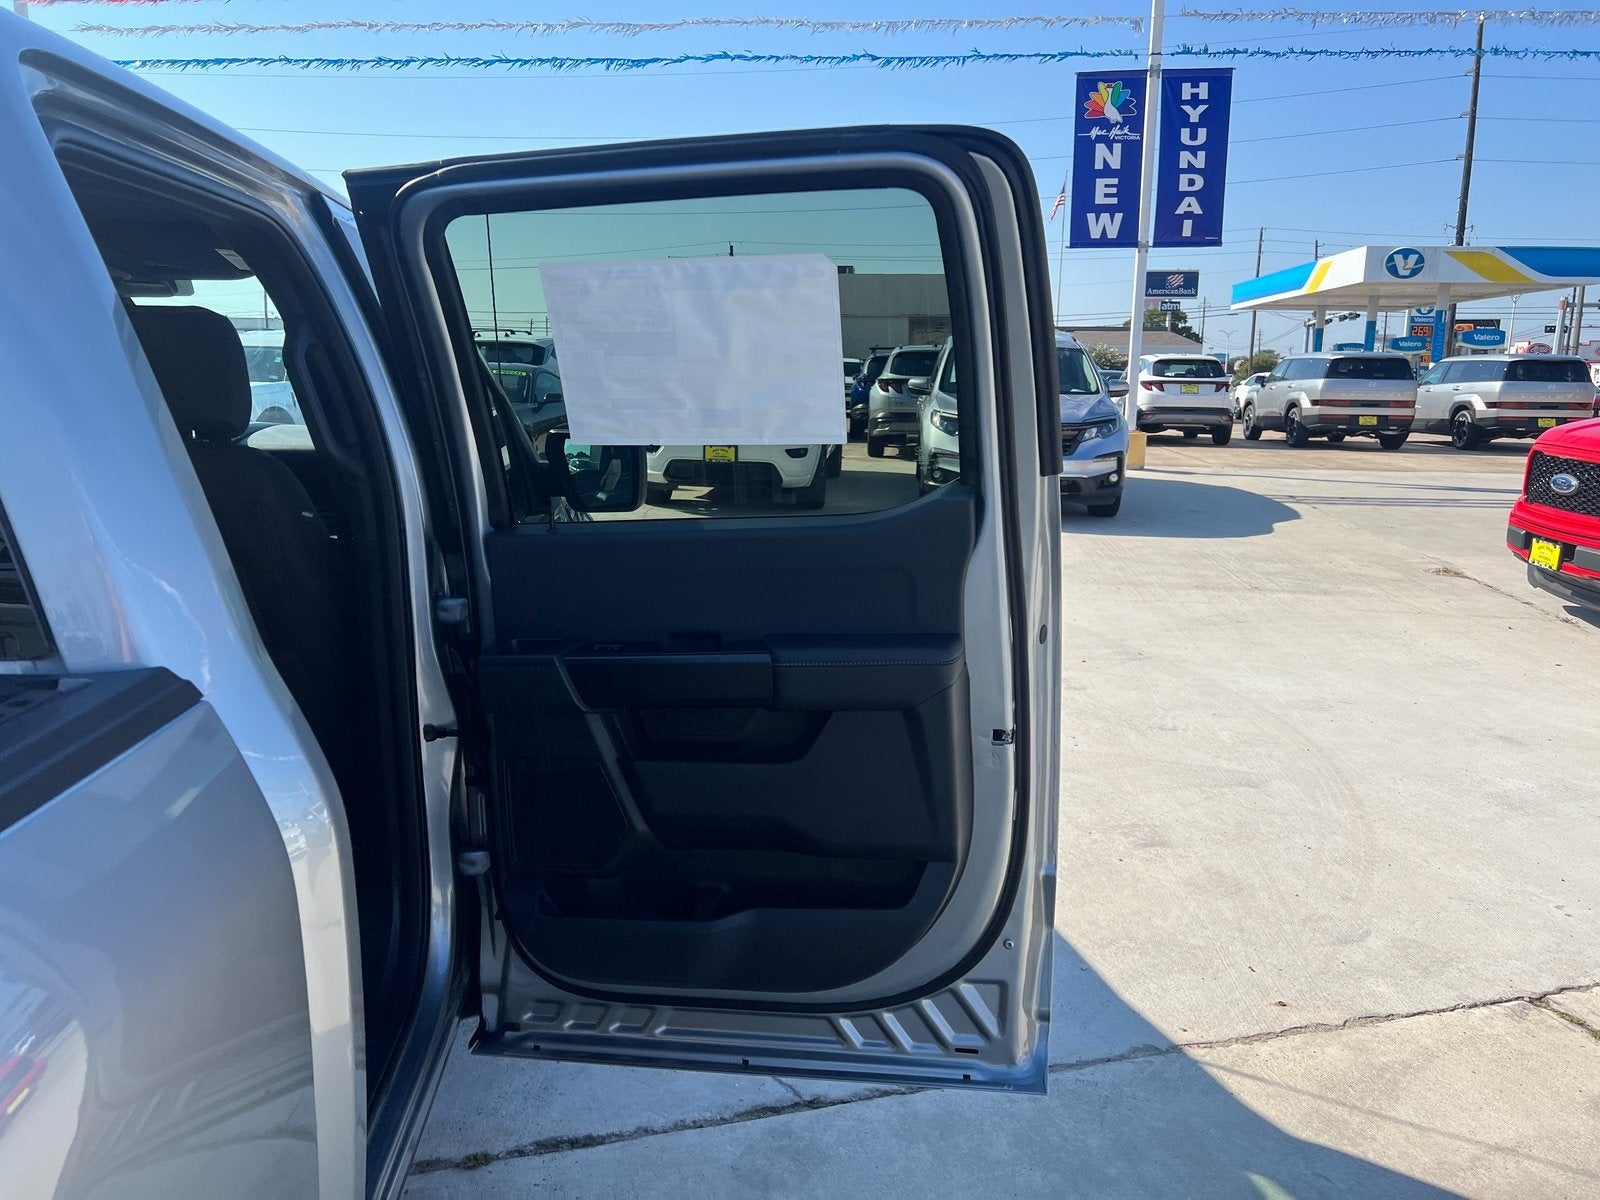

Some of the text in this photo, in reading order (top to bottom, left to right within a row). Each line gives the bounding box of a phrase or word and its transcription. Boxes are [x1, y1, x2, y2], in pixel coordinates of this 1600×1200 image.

[1086, 142, 1124, 239] NEW
[1174, 82, 1210, 237] HYUNDAI
[1161, 302, 1180, 310] atm
